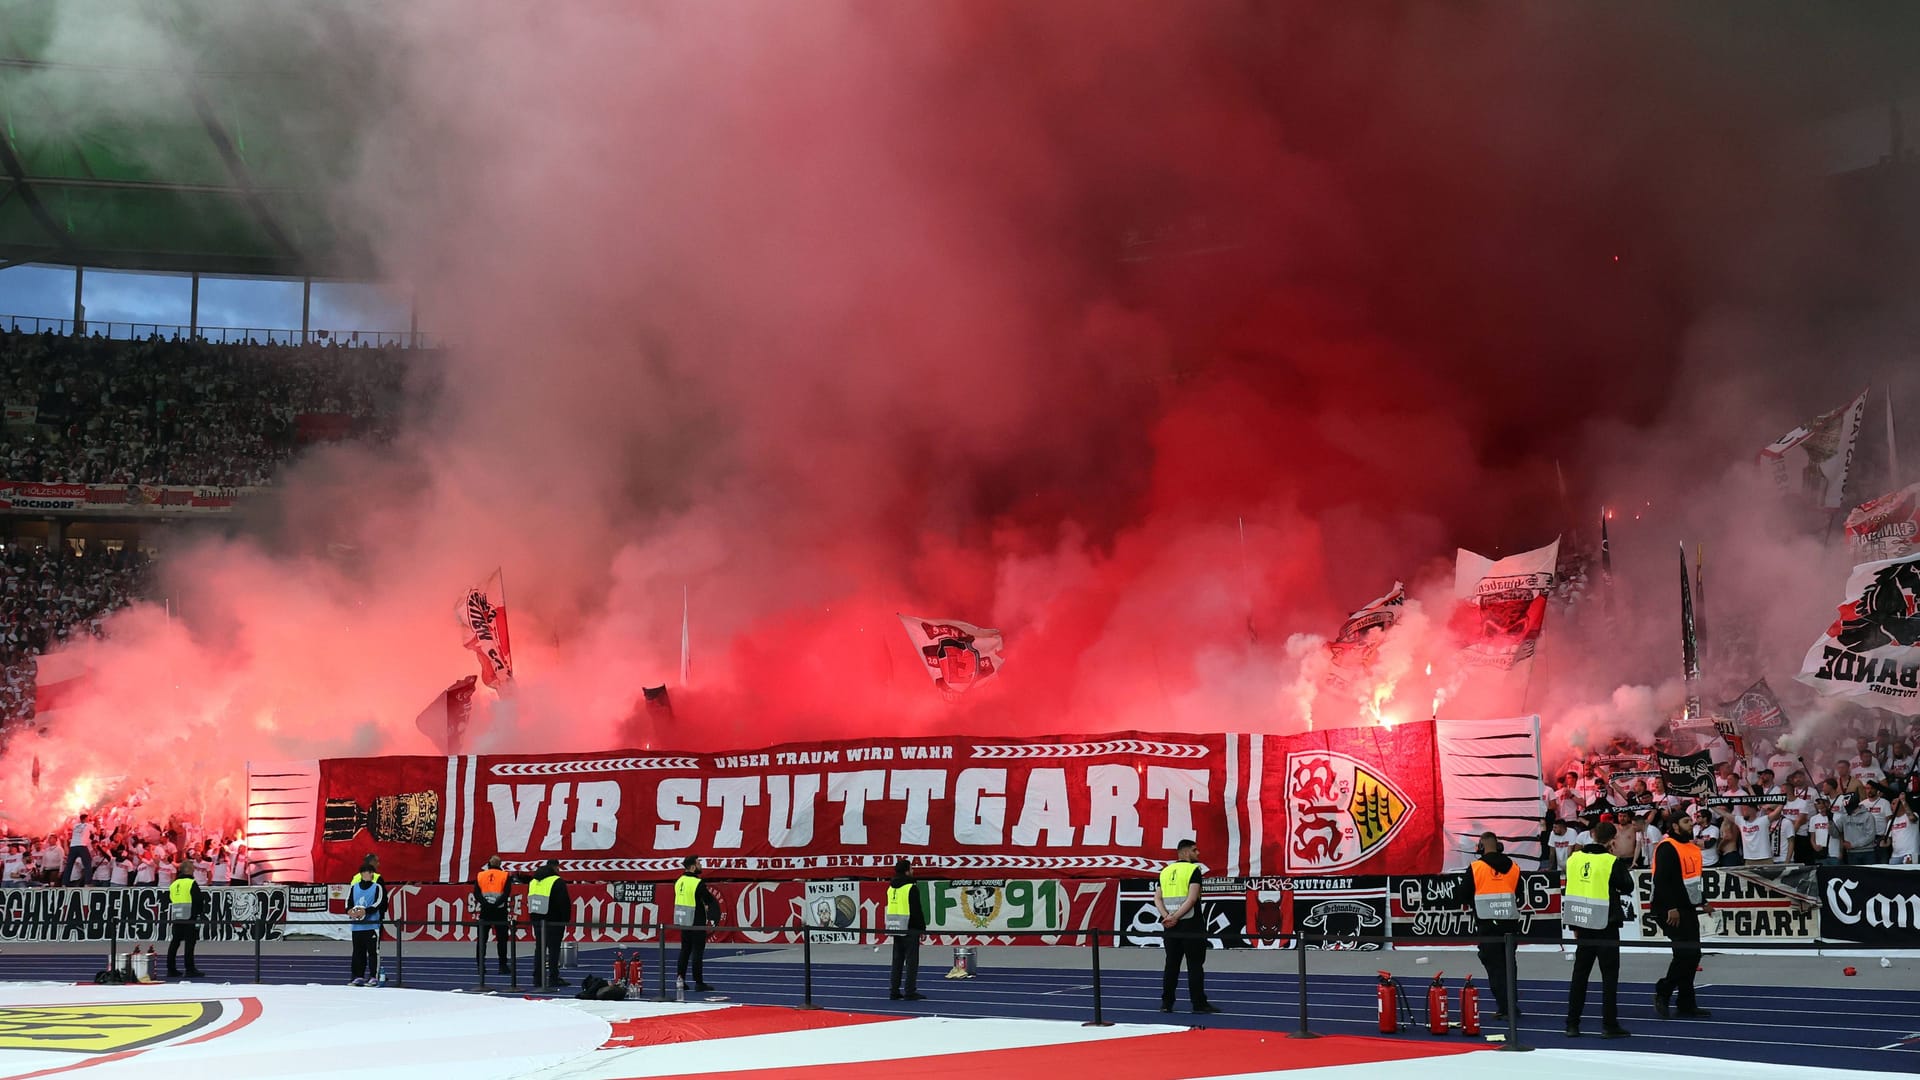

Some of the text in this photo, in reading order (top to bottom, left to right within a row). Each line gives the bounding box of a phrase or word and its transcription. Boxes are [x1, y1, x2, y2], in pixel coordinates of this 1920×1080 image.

[714, 745, 953, 768] UNSER TRAUM WIRD WAHR
[1669, 765, 1690, 774] COPS
[1707, 797, 1729, 805] CREW
[487, 780, 621, 853] VfB
[653, 764, 1210, 850] STUTTGART
[706, 857, 754, 869] WIR
[825, 855, 864, 867] DEN
[808, 883, 834, 894] WSB
[1246, 877, 1353, 890] ULTRAS STUTTGART
[313, 886, 327, 894] UND
[1005, 880, 1057, 928] 91
[810, 931, 856, 942] CESENA
